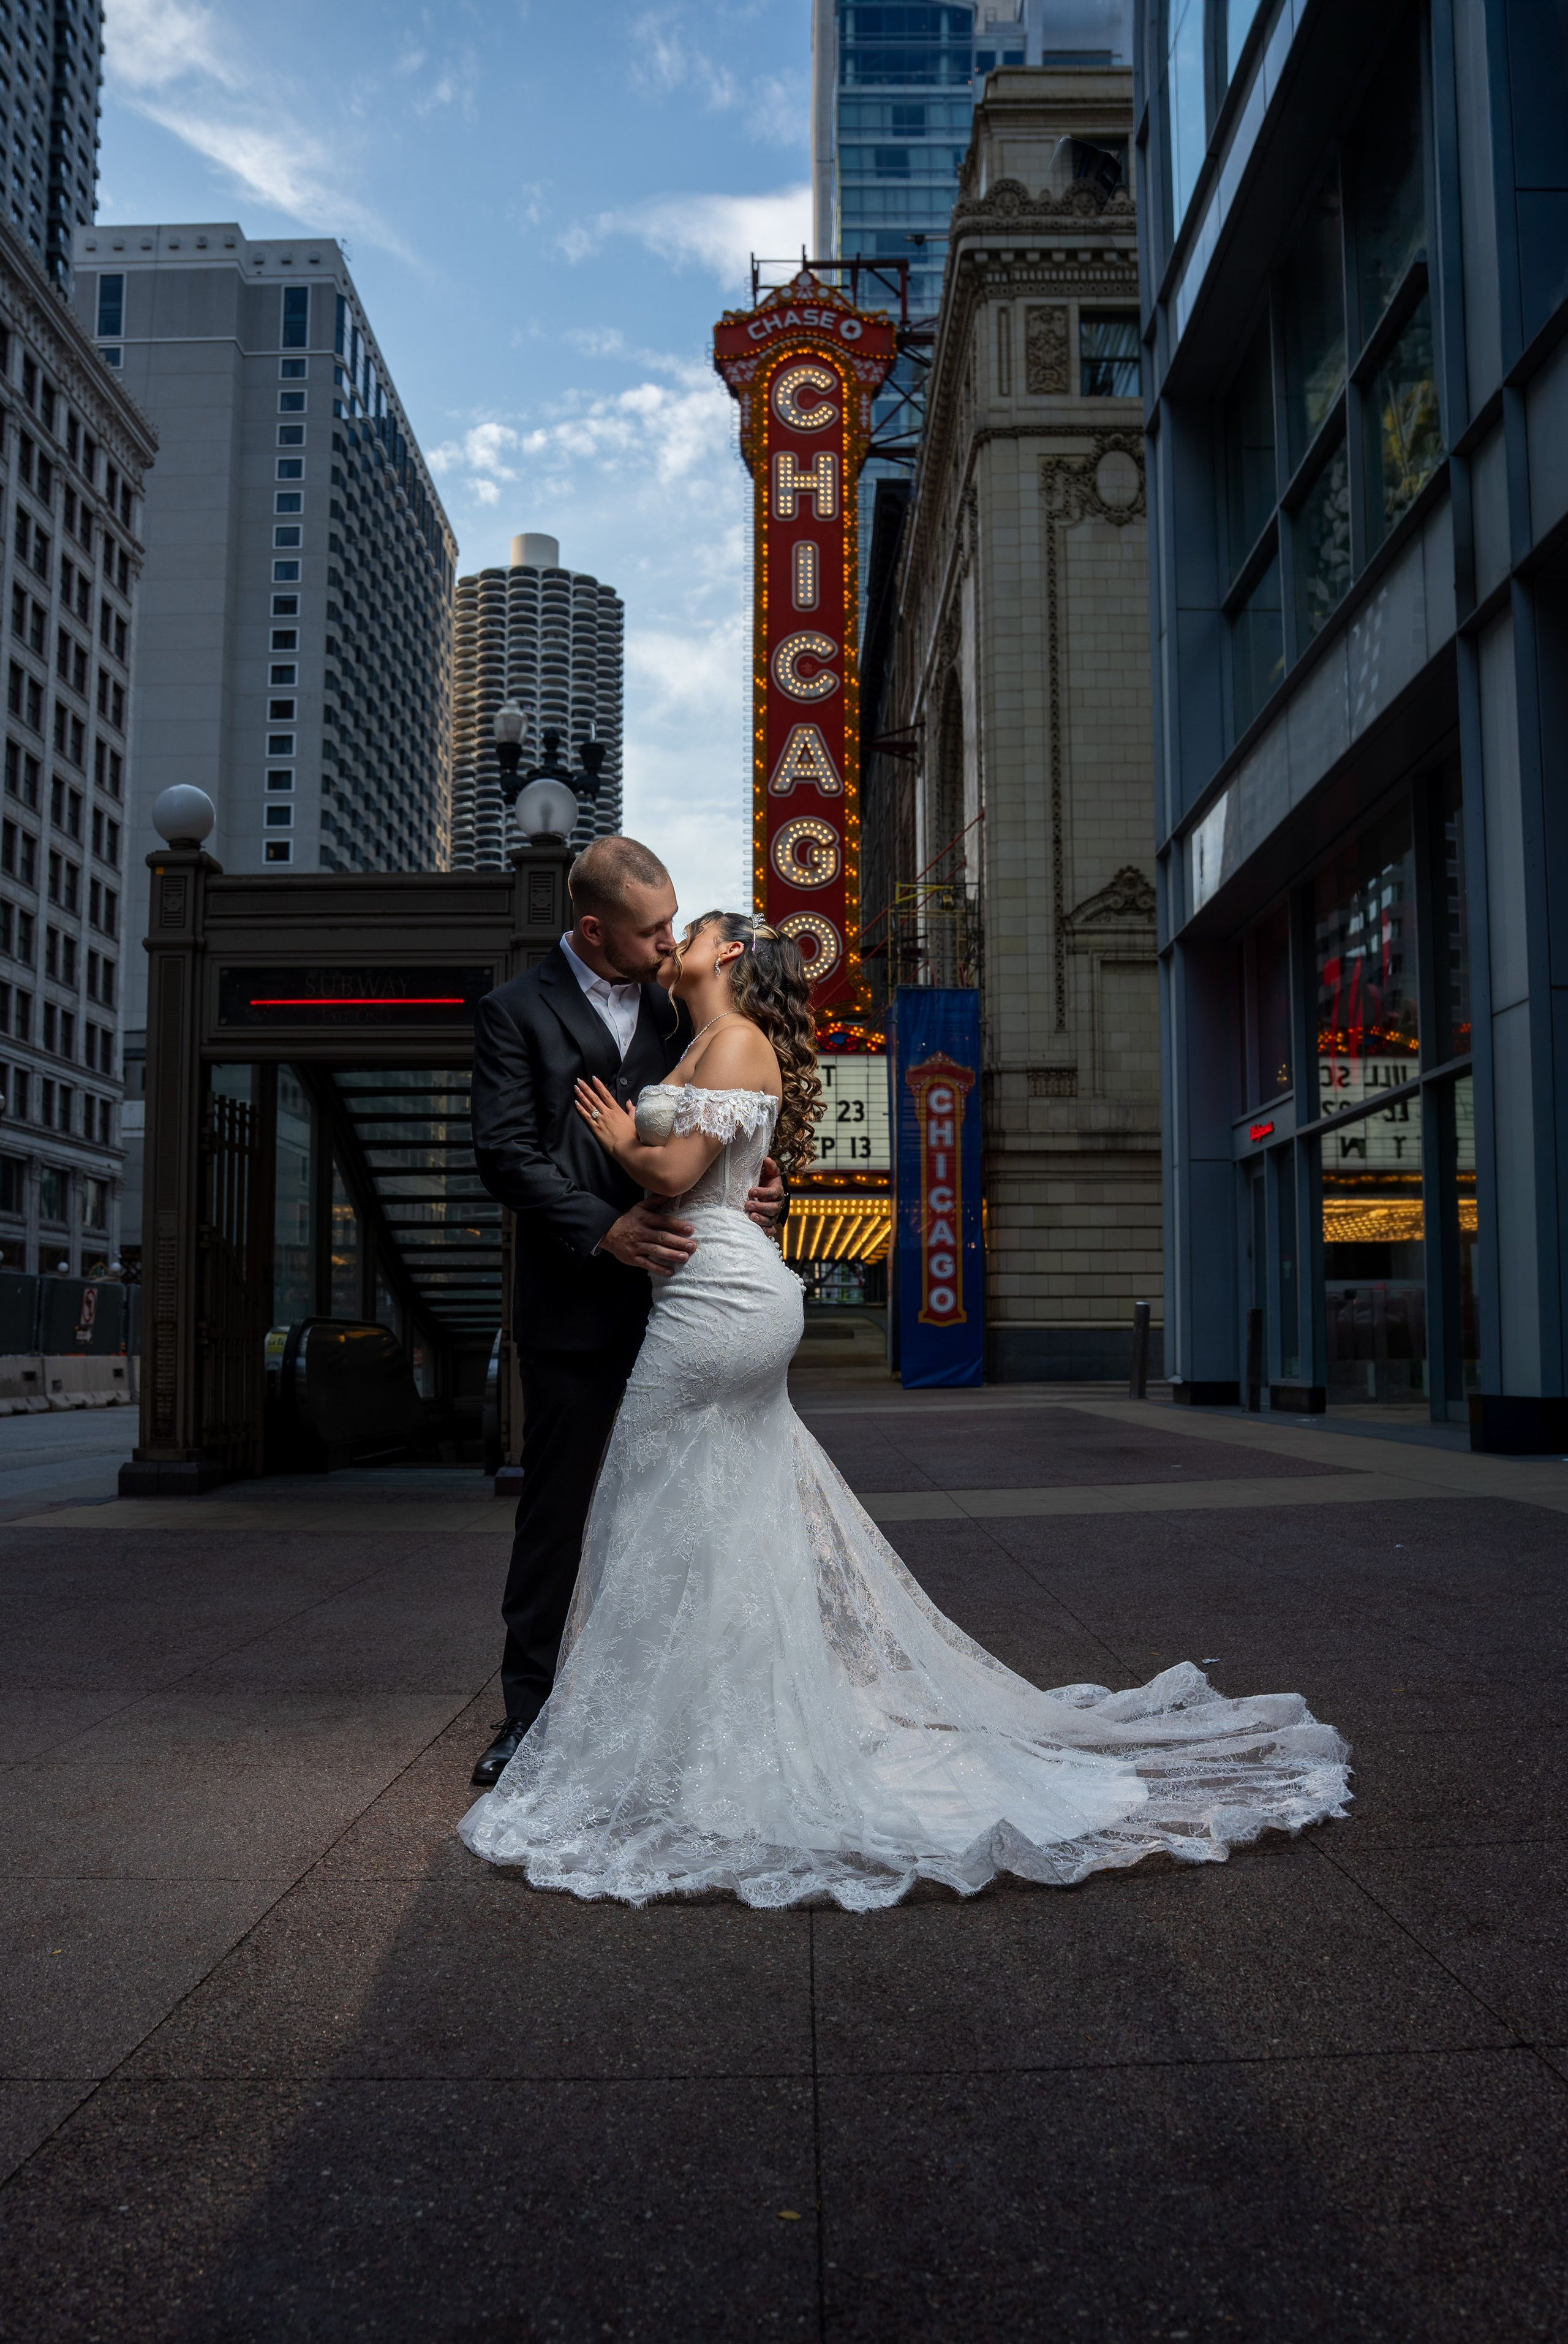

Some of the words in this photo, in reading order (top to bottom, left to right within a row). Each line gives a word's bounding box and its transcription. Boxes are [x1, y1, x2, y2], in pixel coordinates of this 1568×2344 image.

[747, 308, 838, 341] CHASE
[769, 364, 843, 983] CHICAGO
[305, 975, 412, 998] SUBWAY
[817, 1065, 835, 1087] T
[837, 1100, 865, 1122] 23
[851, 1136, 871, 1159] 13
[927, 1088, 956, 1314] CHICAGO
